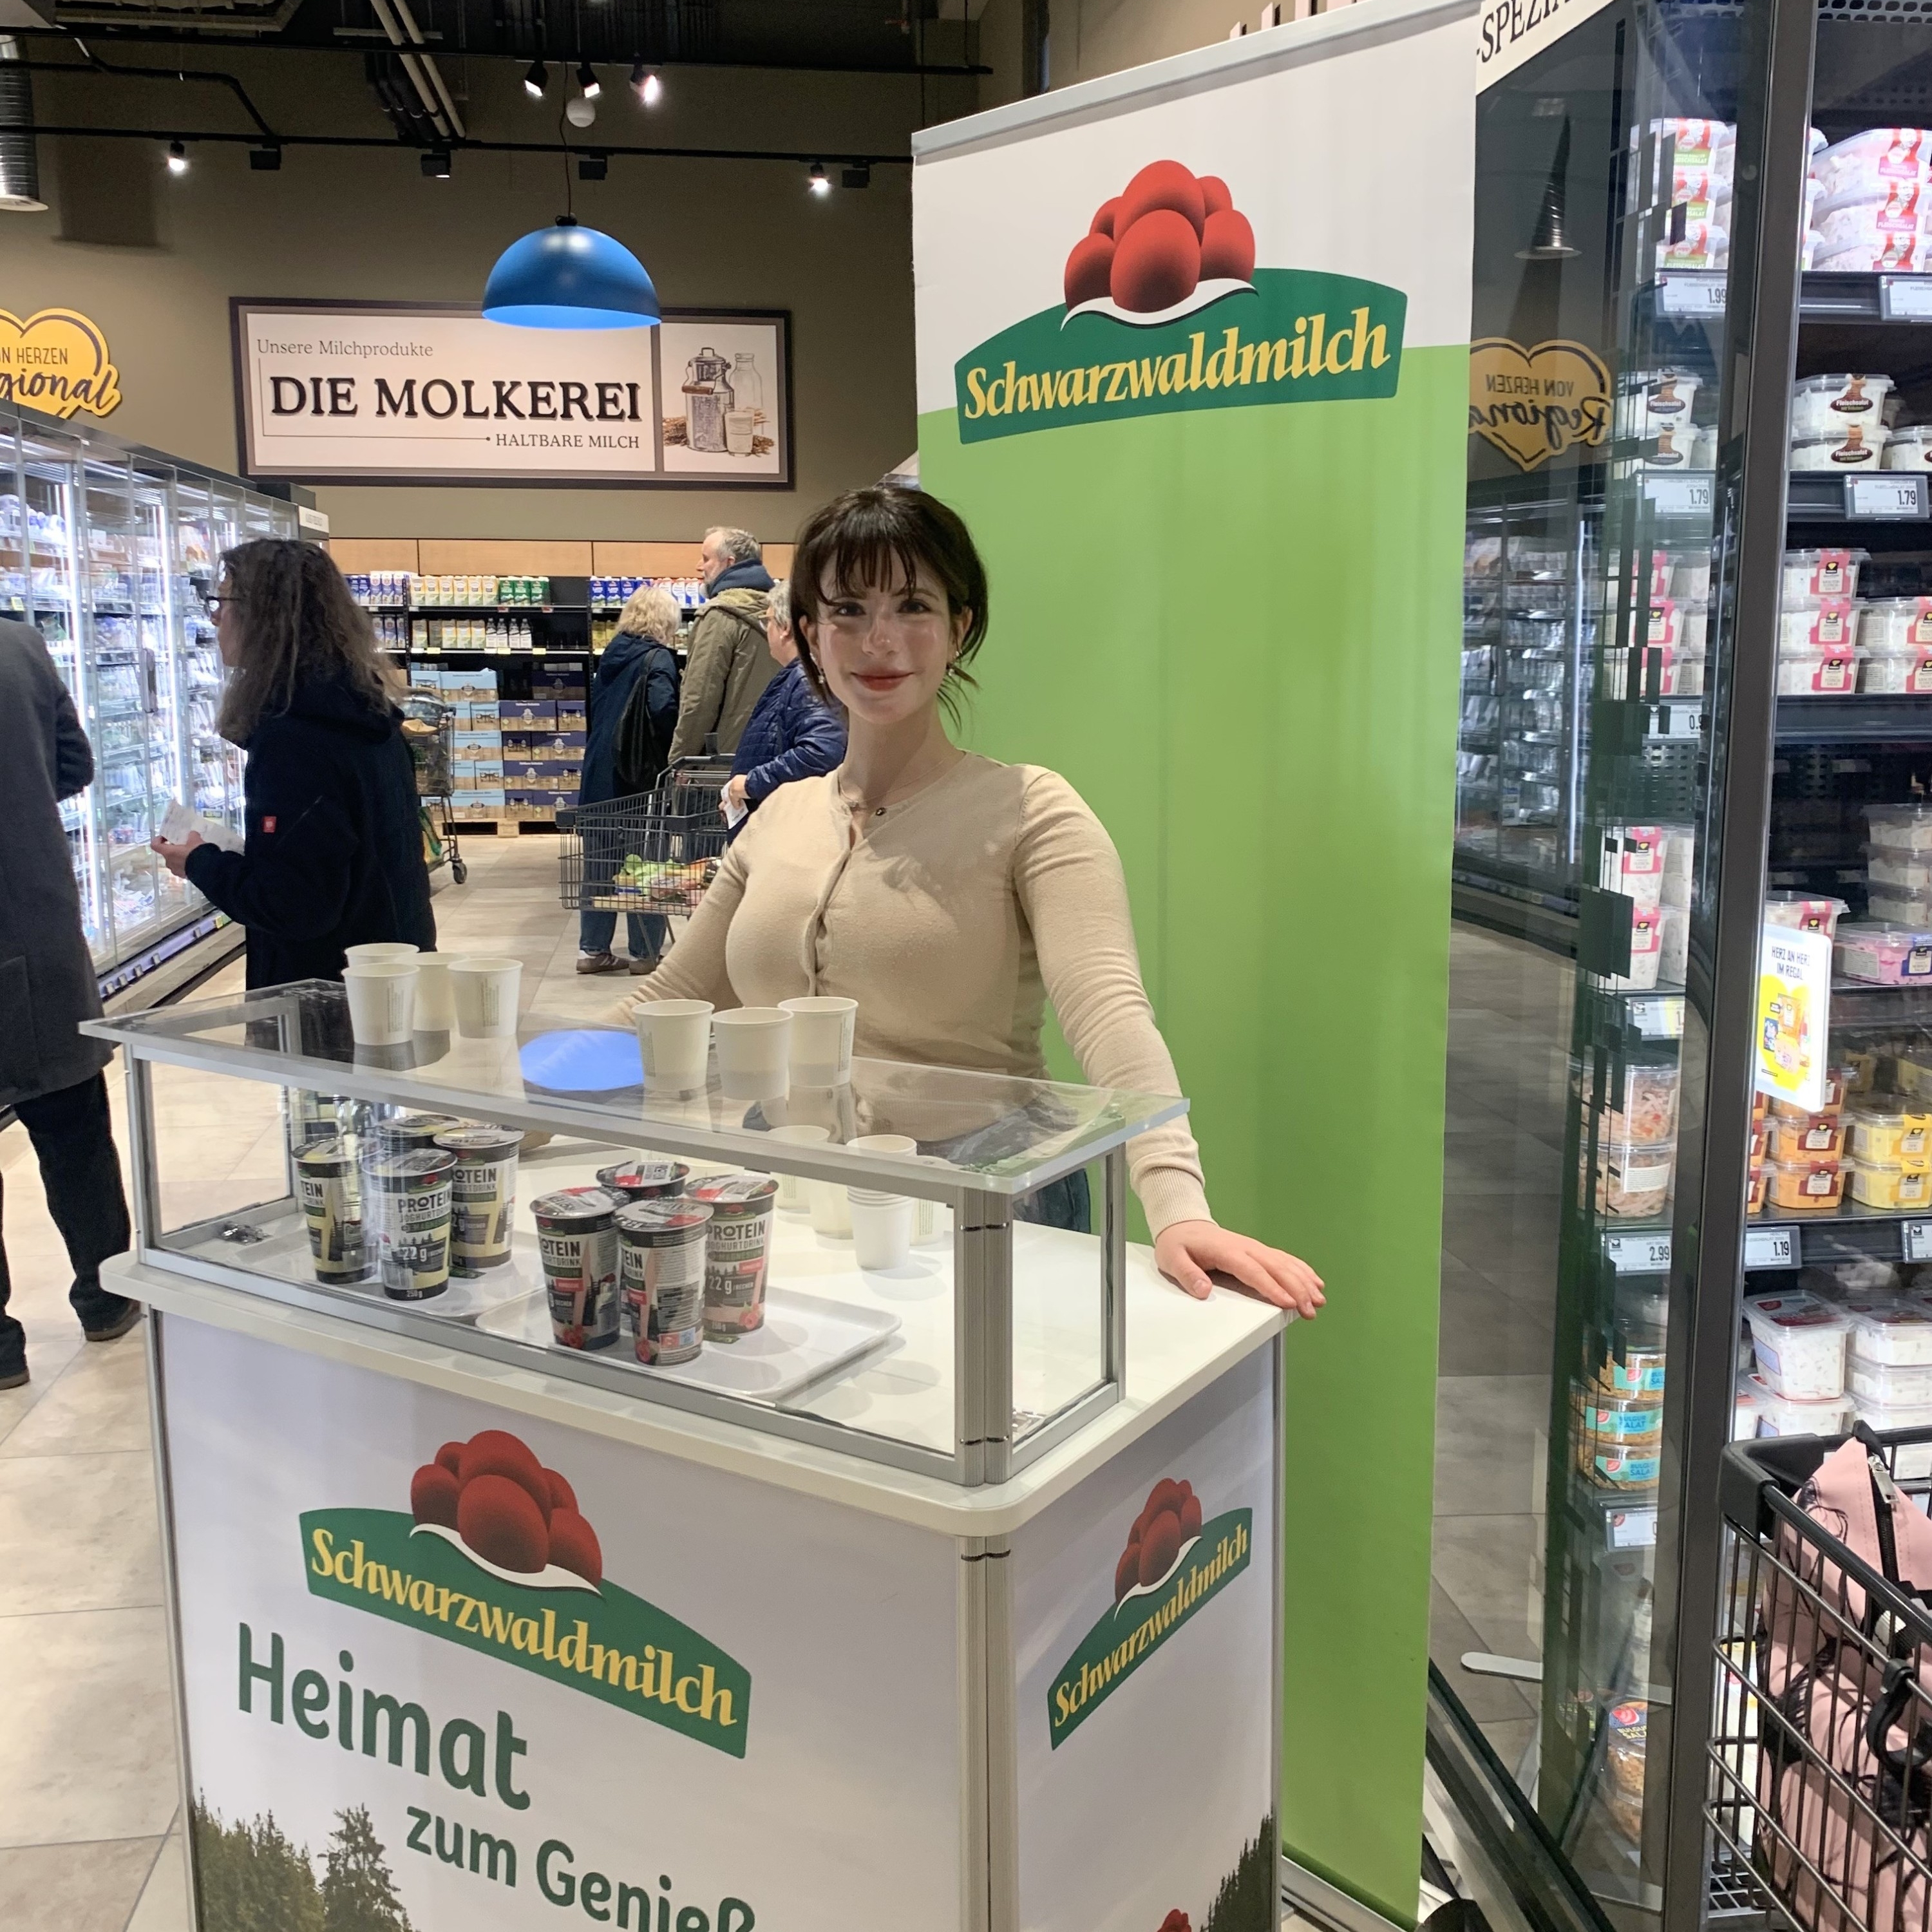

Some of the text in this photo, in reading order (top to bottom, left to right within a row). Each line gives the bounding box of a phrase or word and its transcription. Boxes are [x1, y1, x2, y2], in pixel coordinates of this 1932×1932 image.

[16, 346, 68, 365] HERZEN
[257, 339, 433, 358] Unsere Milchprodukte
[965, 307, 1390, 419] Schwarzwaldmilch
[270, 376, 643, 422] DIE MOLKEREI
[496, 433, 639, 449] HALTBARE MILCH
[1689, 489, 1709, 505] 1.79
[1897, 490, 1917, 505] 1.79
[1772, 946, 1786, 960] HERZ
[1787, 950, 1795, 962] AN
[1777, 963, 1784, 974] IM
[705, 1220, 766, 1240] PROTEIN
[420, 1248, 428, 1262] g
[1649, 1246, 1669, 1261] 2.99
[1774, 1241, 1789, 1256] 1.19
[312, 1528, 738, 1727] Schwarzwaldmilch
[1055, 1524, 1248, 1727] Schwarzwaldmilch
[239, 1622, 531, 1810] Heimat
[407, 1805, 516, 1887] zum
